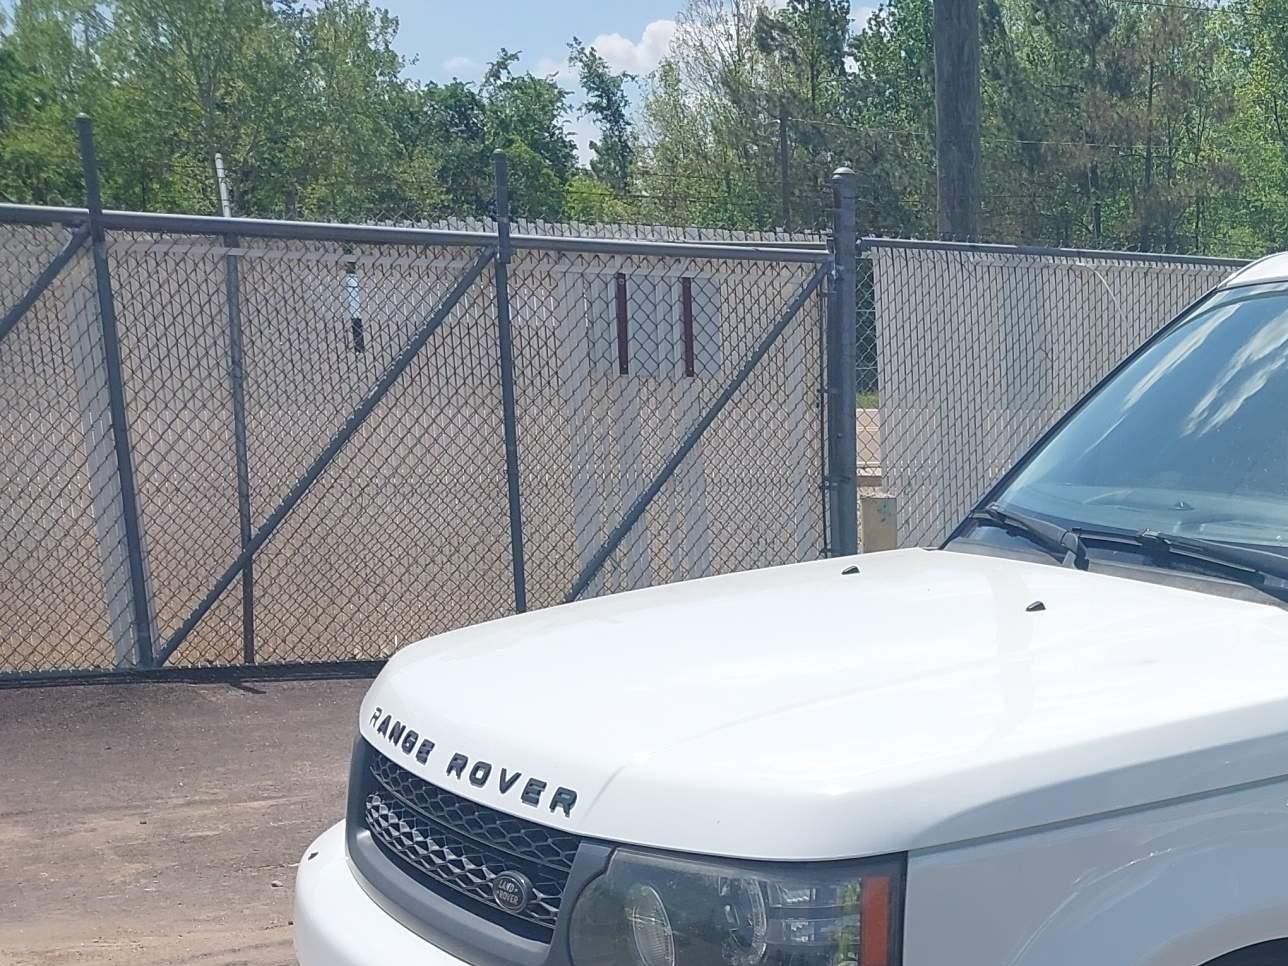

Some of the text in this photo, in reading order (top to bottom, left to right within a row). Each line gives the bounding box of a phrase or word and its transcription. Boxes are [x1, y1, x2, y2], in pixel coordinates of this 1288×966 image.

[369, 706, 578, 818] RANGE ROVER
[499, 889, 519, 906] ROVER
